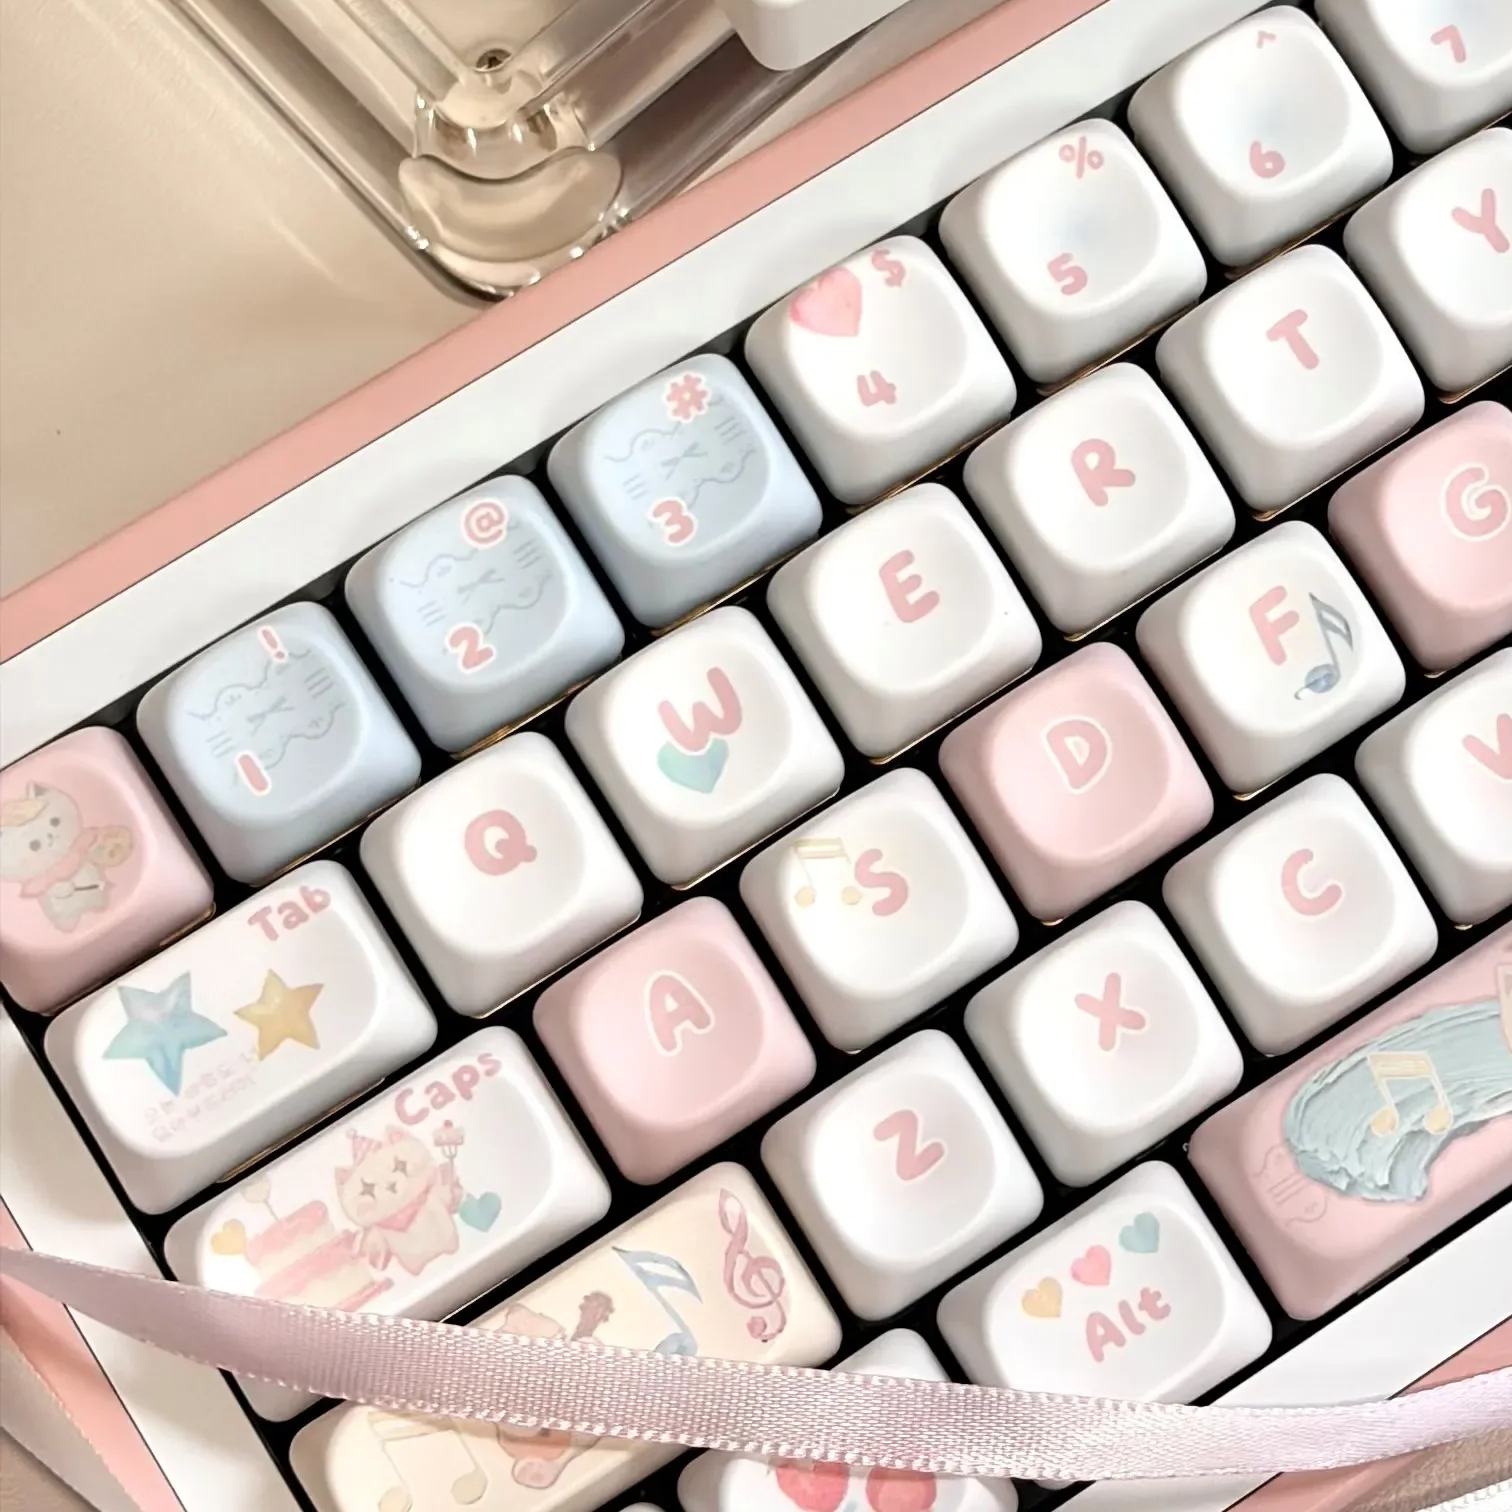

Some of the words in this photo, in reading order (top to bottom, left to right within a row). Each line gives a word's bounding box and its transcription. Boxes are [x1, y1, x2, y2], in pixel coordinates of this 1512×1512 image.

[1431, 25, 1466, 63] 7
[1058, 136, 1104, 179] %
[1249, 140, 1285, 178] 6
[1451, 188, 1511, 253] Y
[871, 249, 907, 287] $
[1047, 254, 1087, 296] 5
[1267, 309, 1319, 370] T
[665, 375, 709, 418] #
[856, 370, 897, 406] 4
[1071, 438, 1136, 507] R
[1443, 465, 1508, 536] G
[464, 502, 505, 543] @
[652, 500, 694, 543] 3
[879, 550, 940, 623] E
[261, 629, 285, 659] !
[450, 626, 494, 669] 2
[1248, 585, 1299, 665] F
[658, 667, 742, 751] W
[1046, 717, 1109, 791] D
[464, 810, 537, 876] Q
[248, 886, 332, 941] Tab
[855, 849, 908, 916] S
[1281, 848, 1343, 916] C
[648, 972, 714, 1052] A
[1076, 973, 1145, 1052] X
[395, 1052, 502, 1126] Caps
[874, 1110, 944, 1181] Z
[1085, 1288, 1172, 1362] Alt
